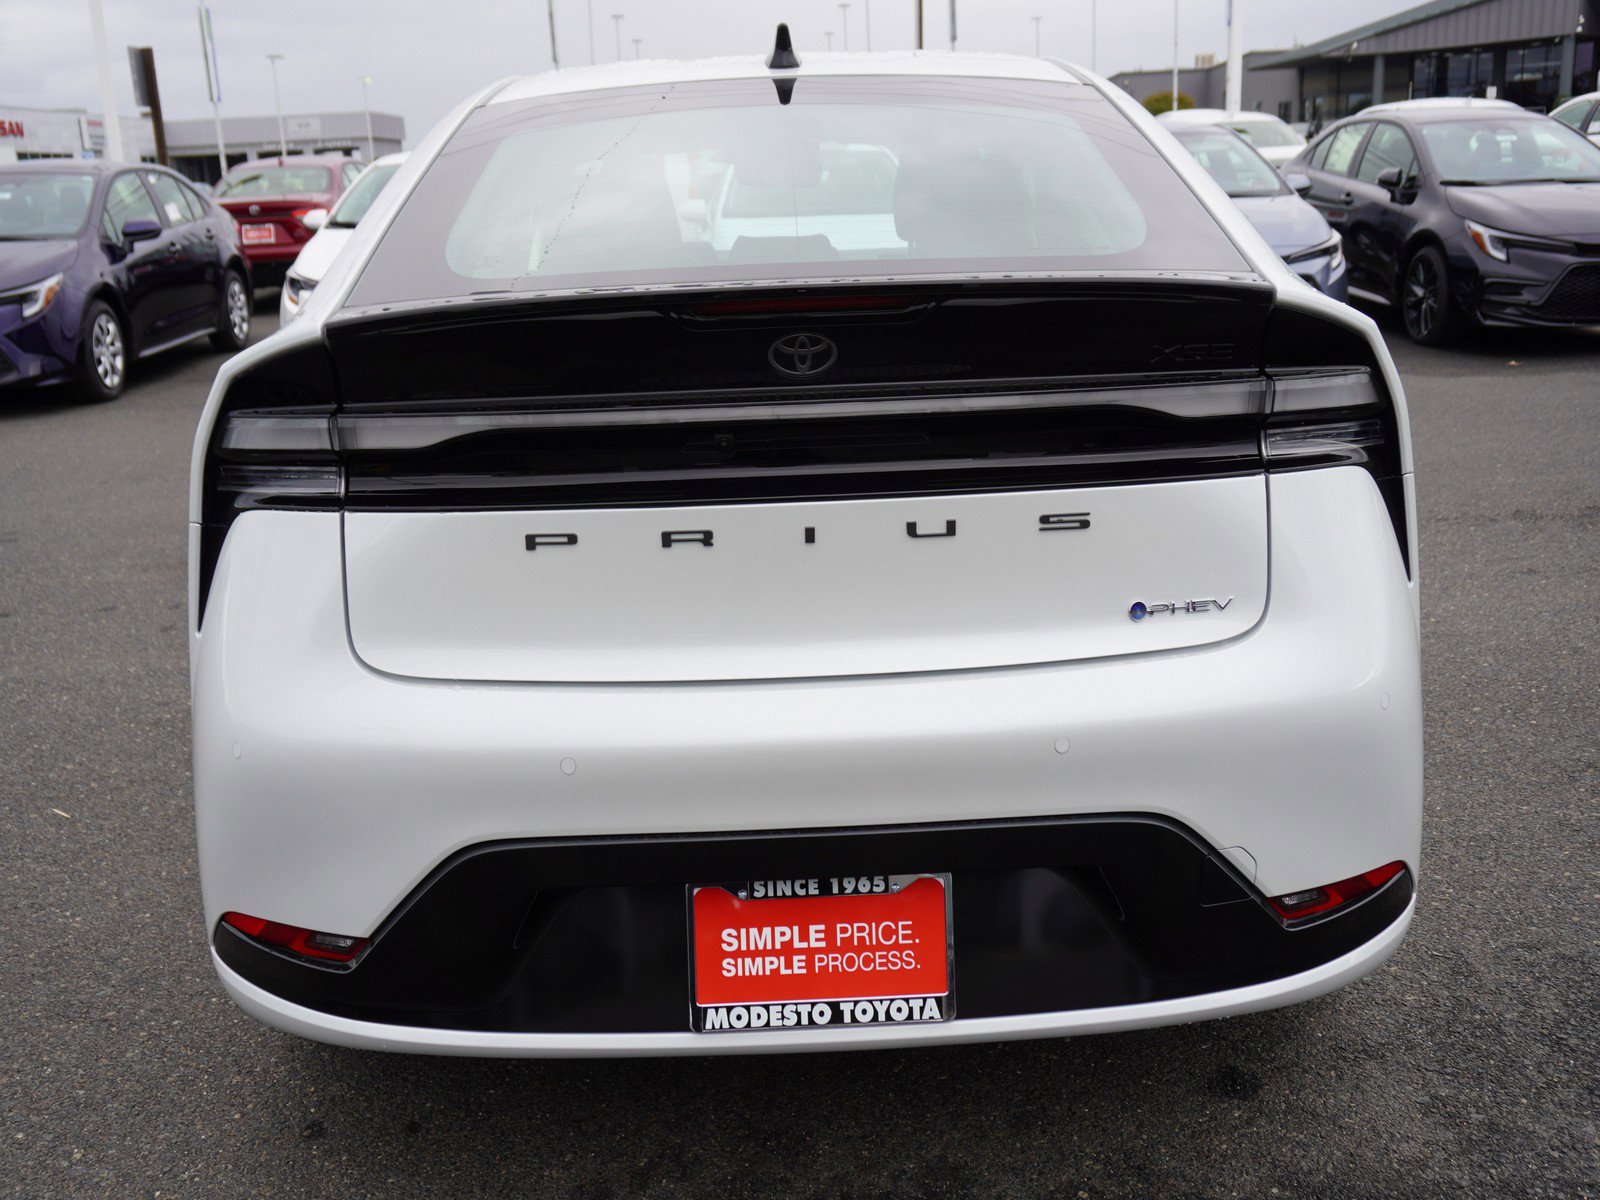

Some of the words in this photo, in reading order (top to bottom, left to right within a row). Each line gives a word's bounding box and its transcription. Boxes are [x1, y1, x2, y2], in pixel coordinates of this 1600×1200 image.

[525, 512, 1091, 551] PRIUS
[1147, 596, 1234, 616] PHEV
[753, 879, 820, 898] SINCE
[830, 876, 886, 894] 1965
[721, 925, 826, 952] SIMPLE
[836, 921, 920, 947] PRICE.
[721, 955, 807, 978] SIMPLE
[814, 950, 921, 973] PROCESS.
[705, 1002, 833, 1030] MODESTO
[840, 998, 942, 1023] TOYOTA
